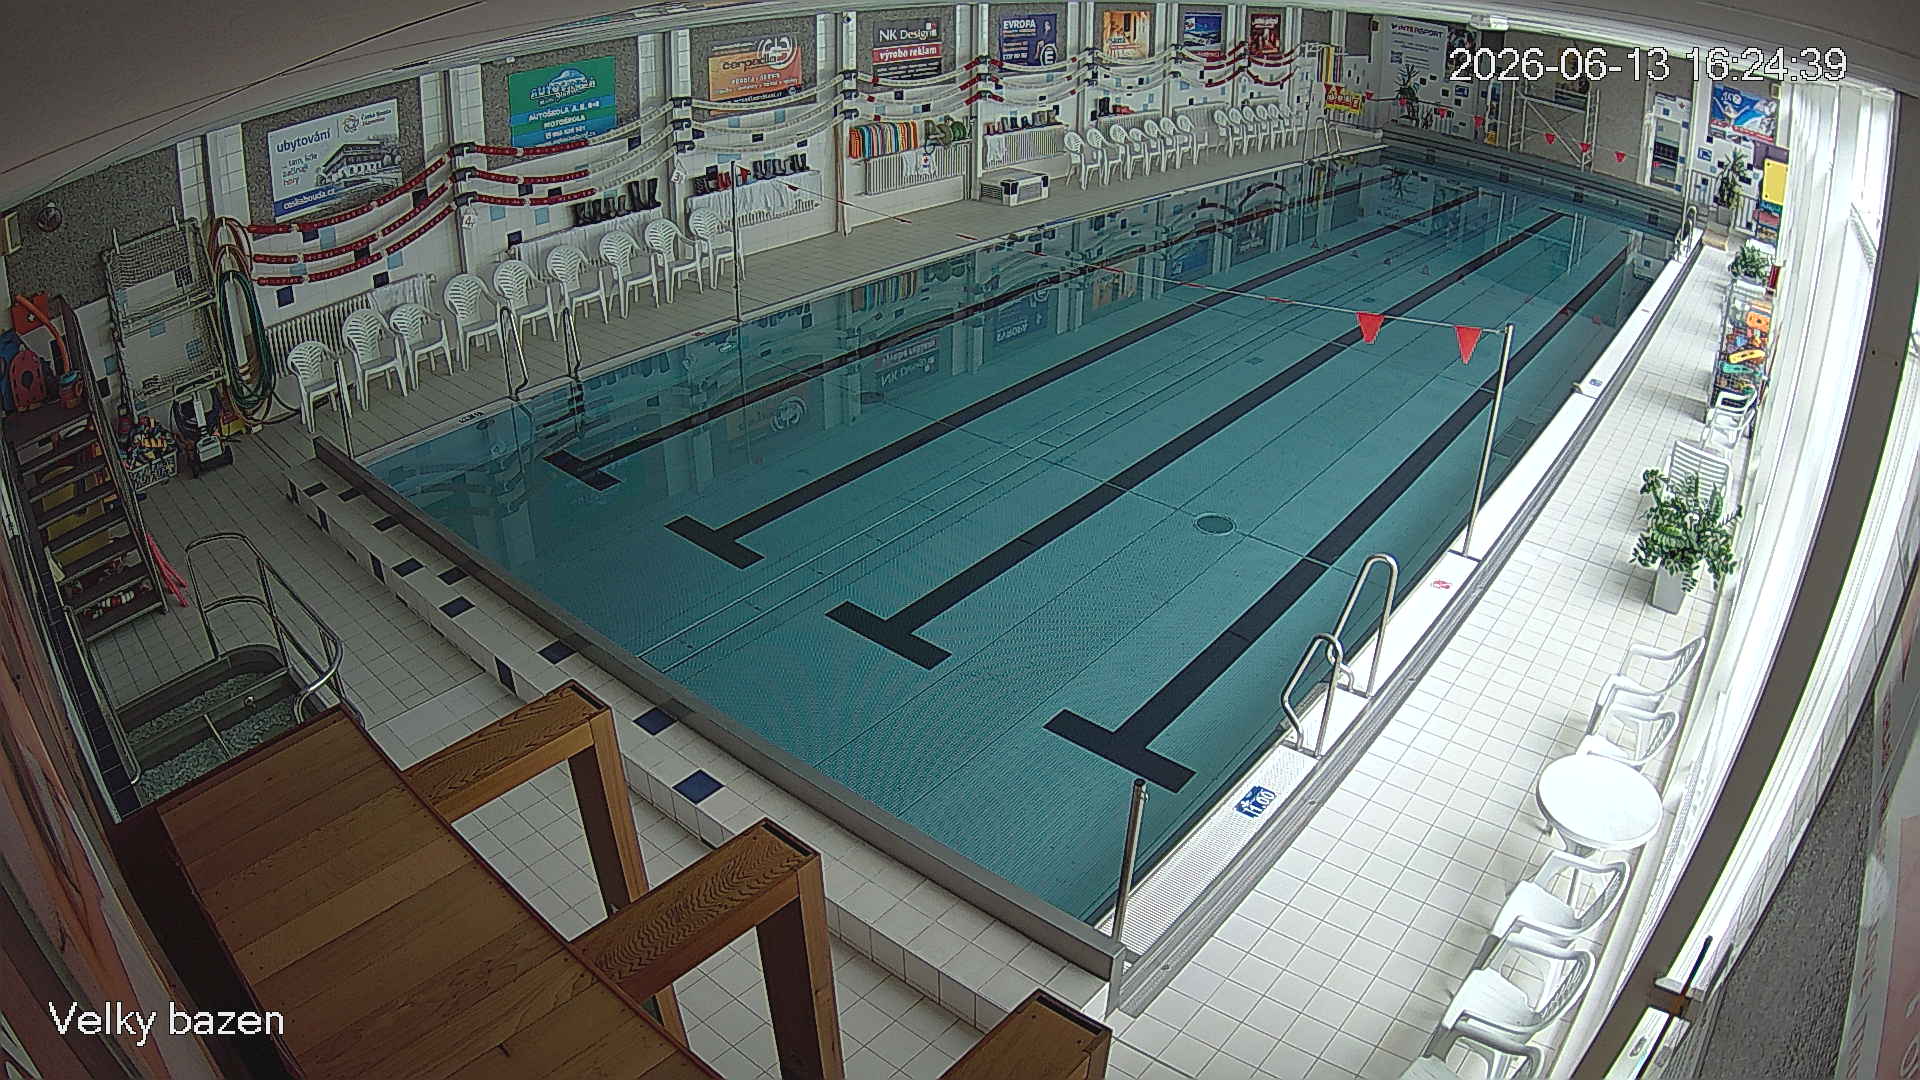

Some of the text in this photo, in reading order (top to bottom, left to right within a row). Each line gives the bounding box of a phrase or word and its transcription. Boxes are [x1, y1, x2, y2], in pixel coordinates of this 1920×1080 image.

[1003, 19, 1037, 29] EVROPA
[879, 27, 931, 42] NK Design
[276, 127, 331, 153] ubytování
